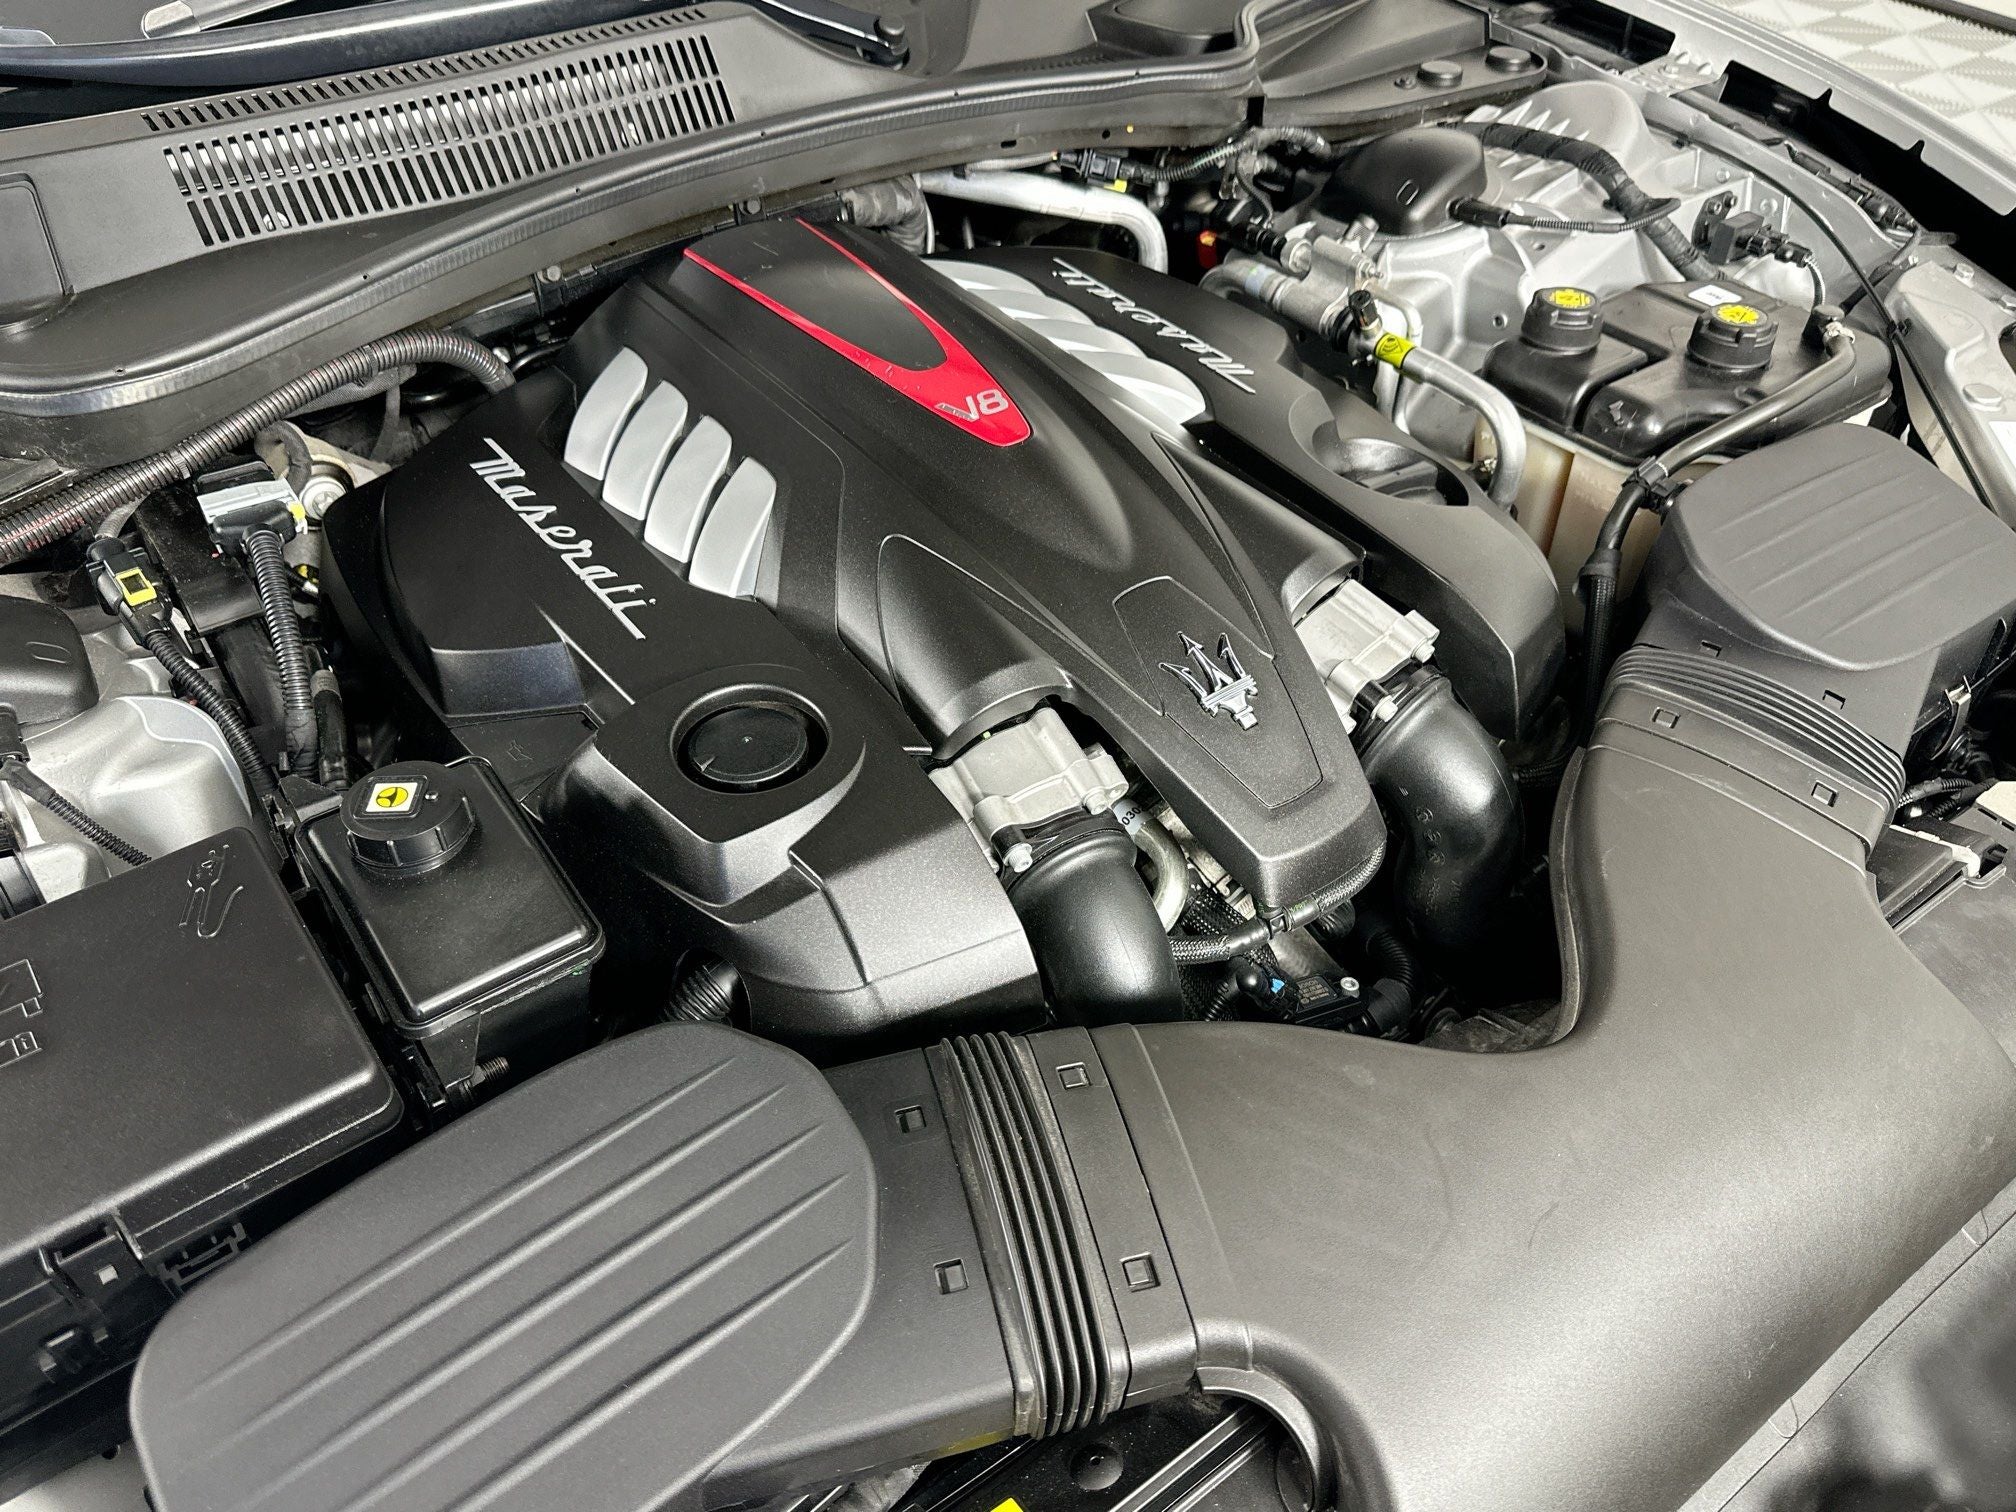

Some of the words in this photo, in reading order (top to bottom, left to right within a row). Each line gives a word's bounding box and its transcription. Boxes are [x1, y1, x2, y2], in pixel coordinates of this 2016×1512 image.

[1052, 257, 1256, 394] Maserati
[934, 388, 1009, 422] V8
[469, 437, 656, 640] Maserati
